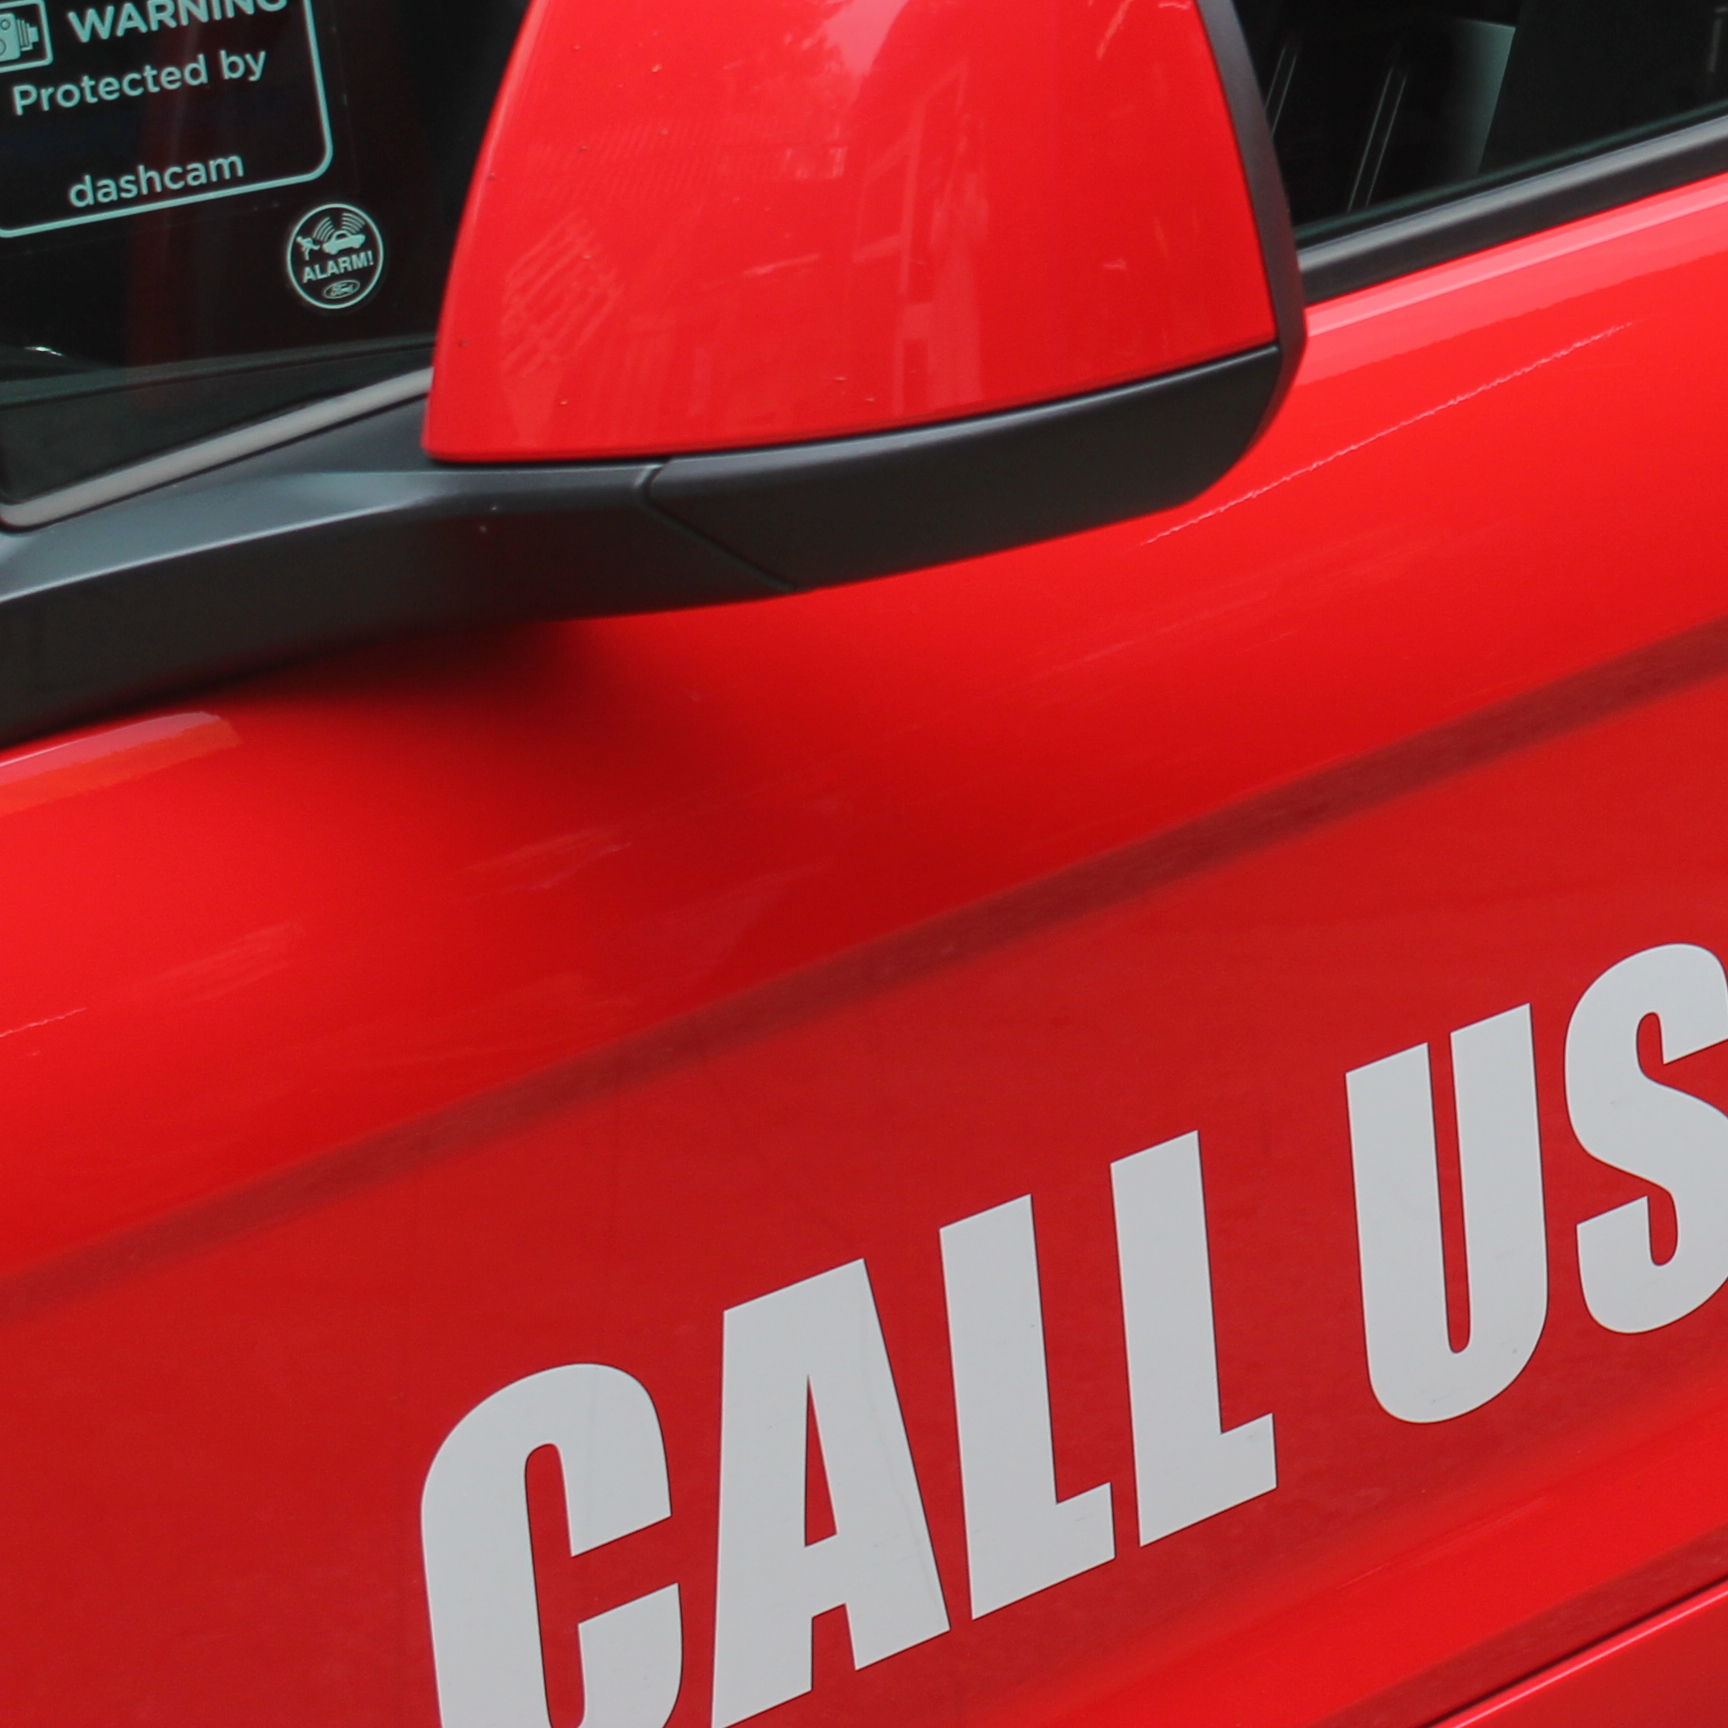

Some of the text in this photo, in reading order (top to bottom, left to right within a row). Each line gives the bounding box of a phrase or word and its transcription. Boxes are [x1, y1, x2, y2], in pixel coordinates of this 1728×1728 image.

[12, 49, 266, 115] Protected by
[69, 155, 244, 207] dashcam
[303, 251, 374, 283] ALARM!
[421, 1131, 1277, 1728] CALL
